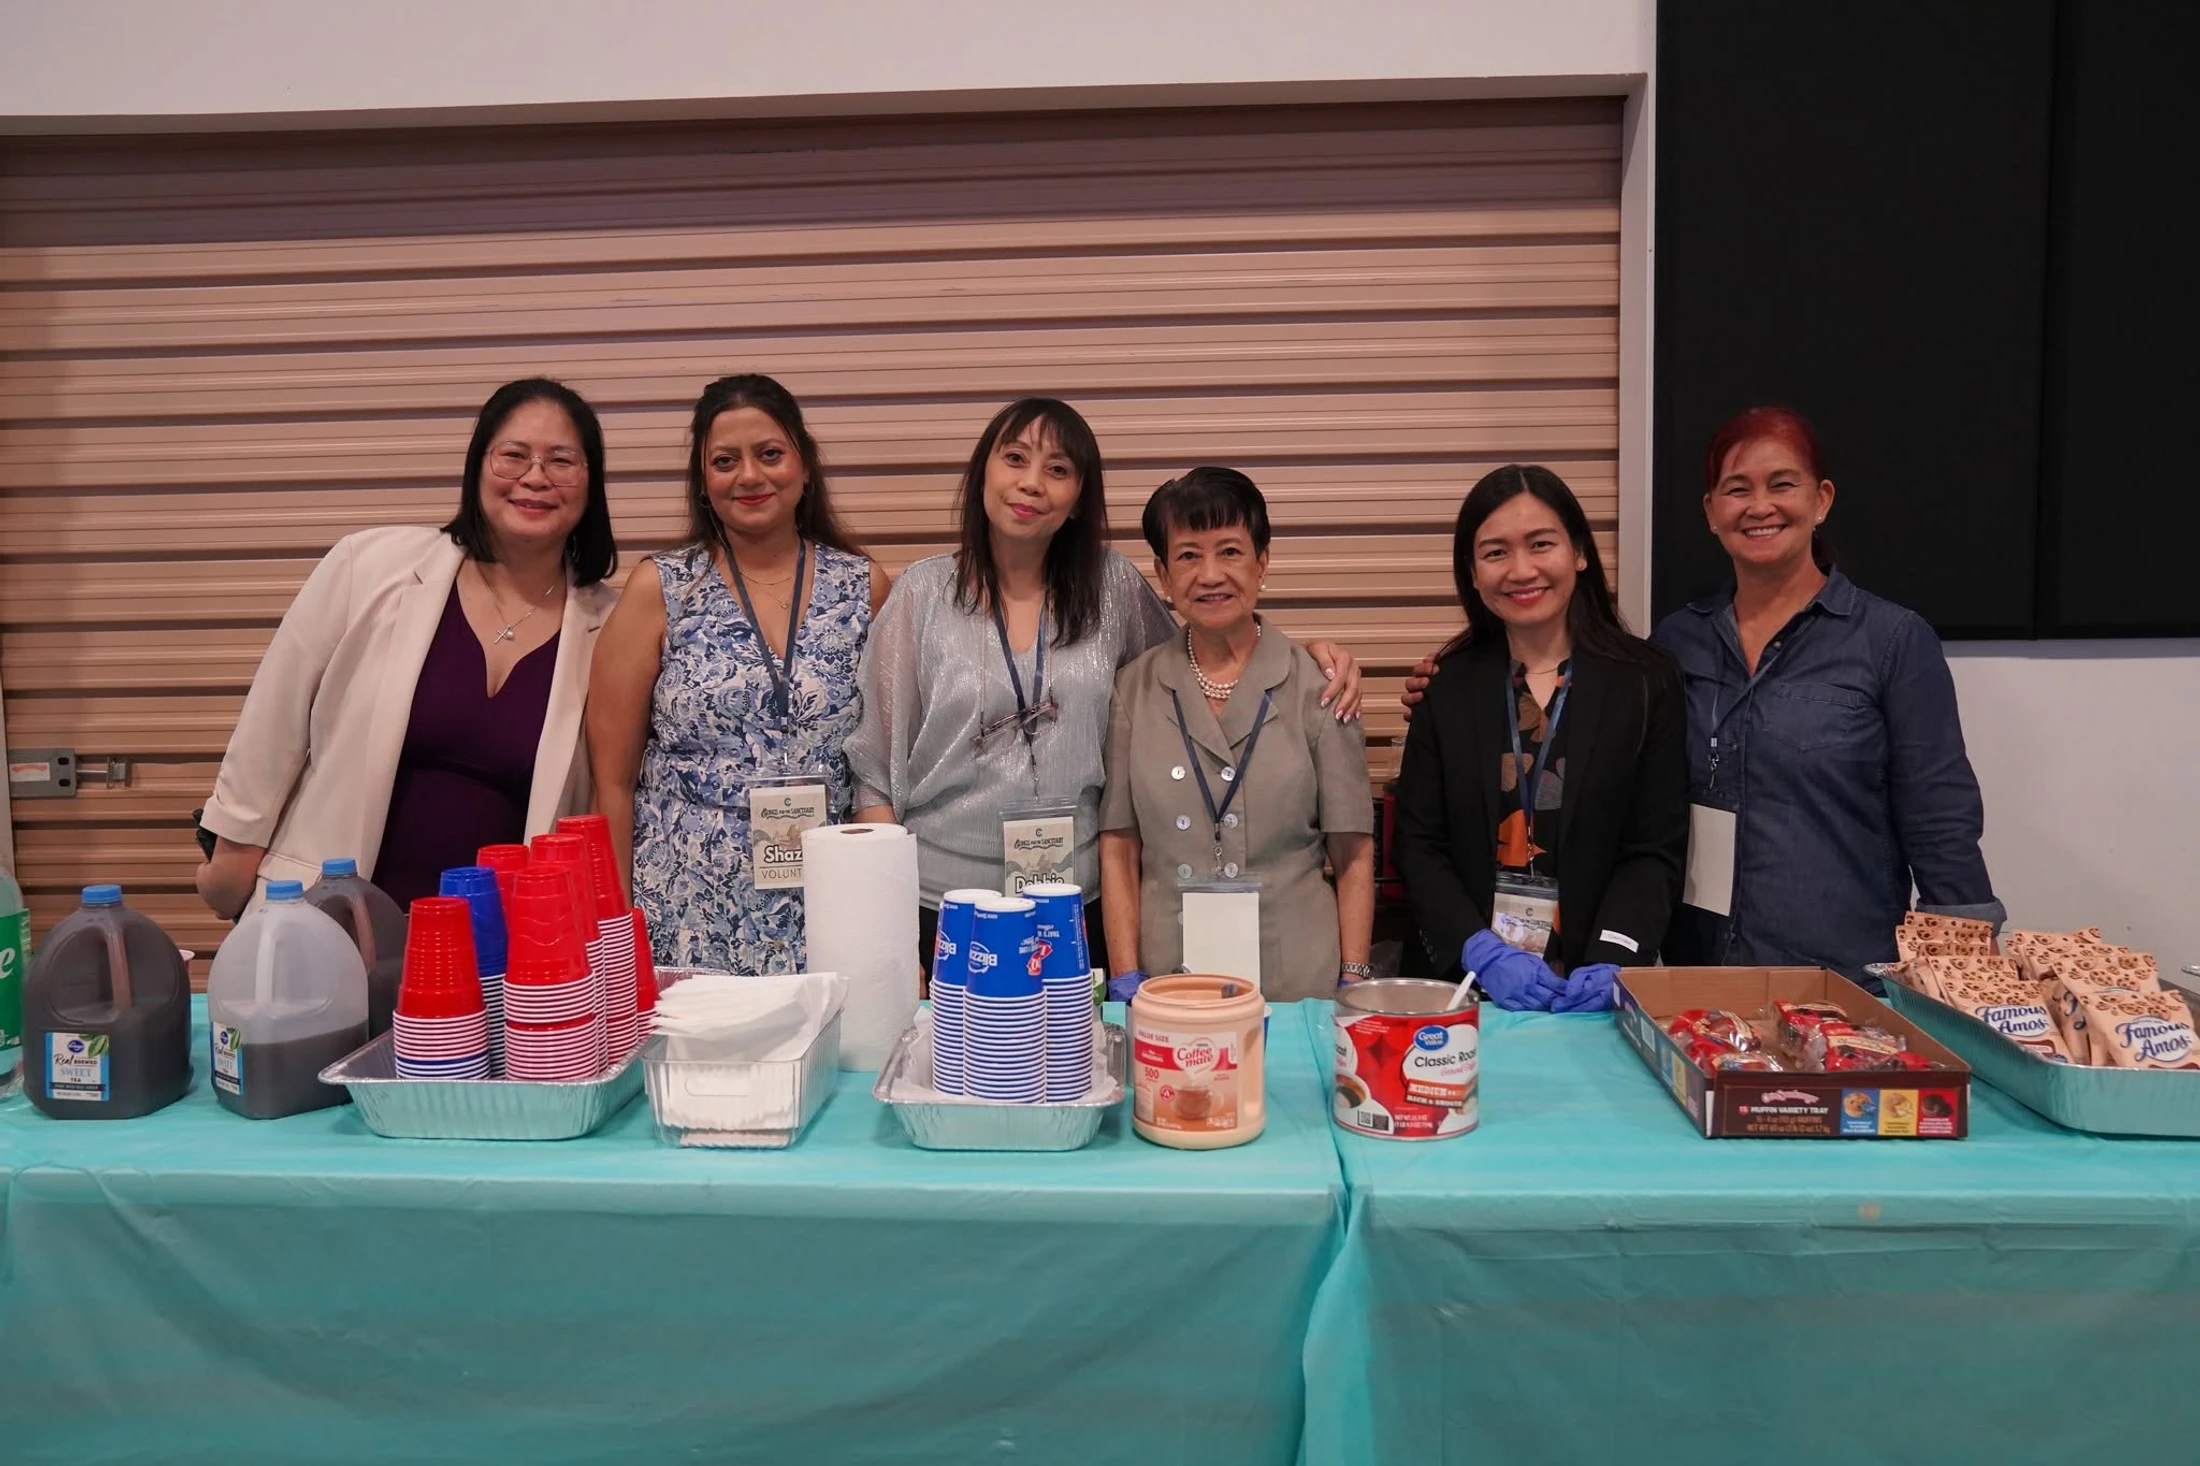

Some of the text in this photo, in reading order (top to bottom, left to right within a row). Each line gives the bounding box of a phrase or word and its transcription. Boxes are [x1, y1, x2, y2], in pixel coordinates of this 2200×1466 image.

[764, 845, 803, 863] Shaz
[761, 868, 802, 879] VOLUNT
[969, 950, 998, 966] Blizz
[1975, 1005, 2047, 1023] Famous
[1998, 1020, 2047, 1034] Amos
[1138, 1030, 1169, 1043] VALUE SIZE
[1418, 1031, 1443, 1042] Great
[2115, 1022, 2190, 1048] Famous
[1177, 1047, 1213, 1061] Coffee
[2134, 1035, 2191, 1062] Amos
[1186, 1054, 1213, 1067] mate
[1414, 1054, 1456, 1068] Classic
[1144, 1067, 1159, 1079] 500
[1750, 1106, 1778, 1114] MUFFIN
